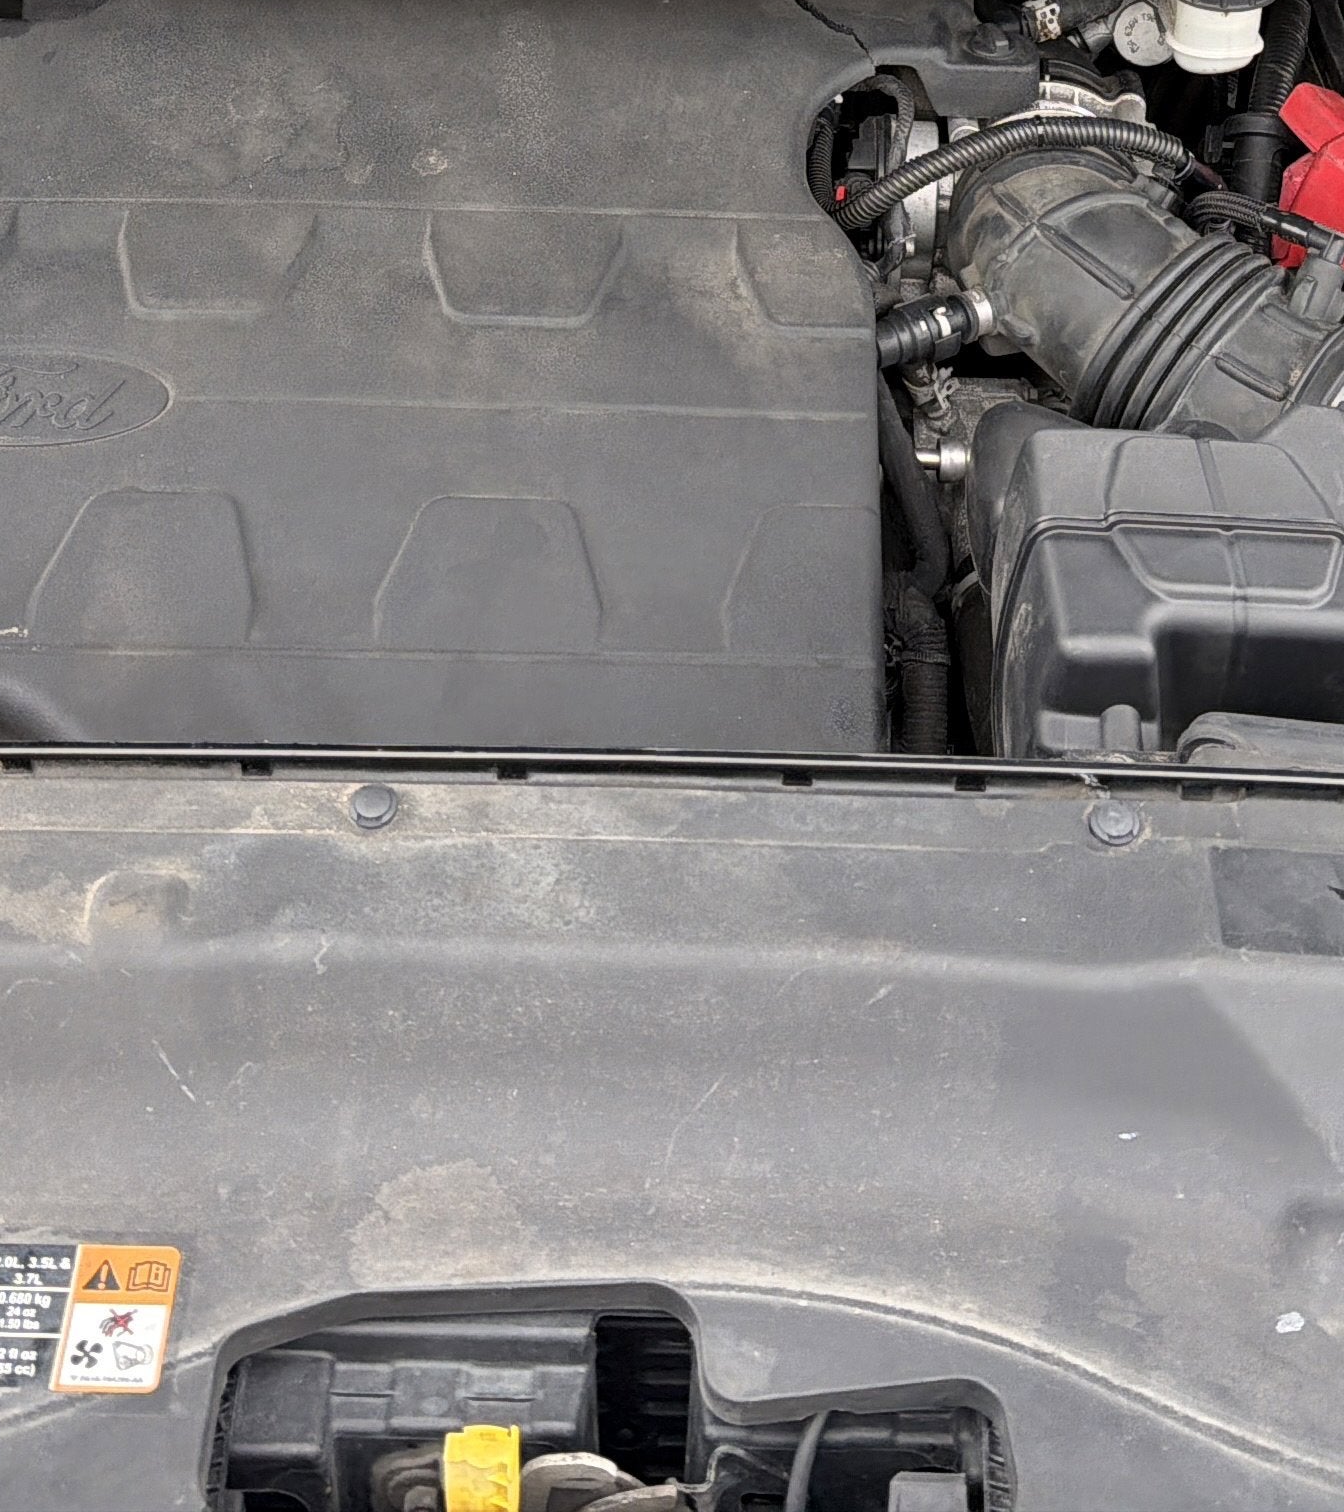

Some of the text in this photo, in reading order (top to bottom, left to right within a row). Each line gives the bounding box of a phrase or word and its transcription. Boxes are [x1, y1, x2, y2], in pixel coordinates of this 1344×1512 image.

[27, 1257, 58, 1270] 3.5L
[59, 1257, 71, 1269] &
[13, 1273, 43, 1285] 3.7L
[34, 1293, 52, 1308] kg
[6, 1306, 37, 1317] 24 oz
[23, 1318, 40, 1330] lbs
[20, 1350, 38, 1361] oz
